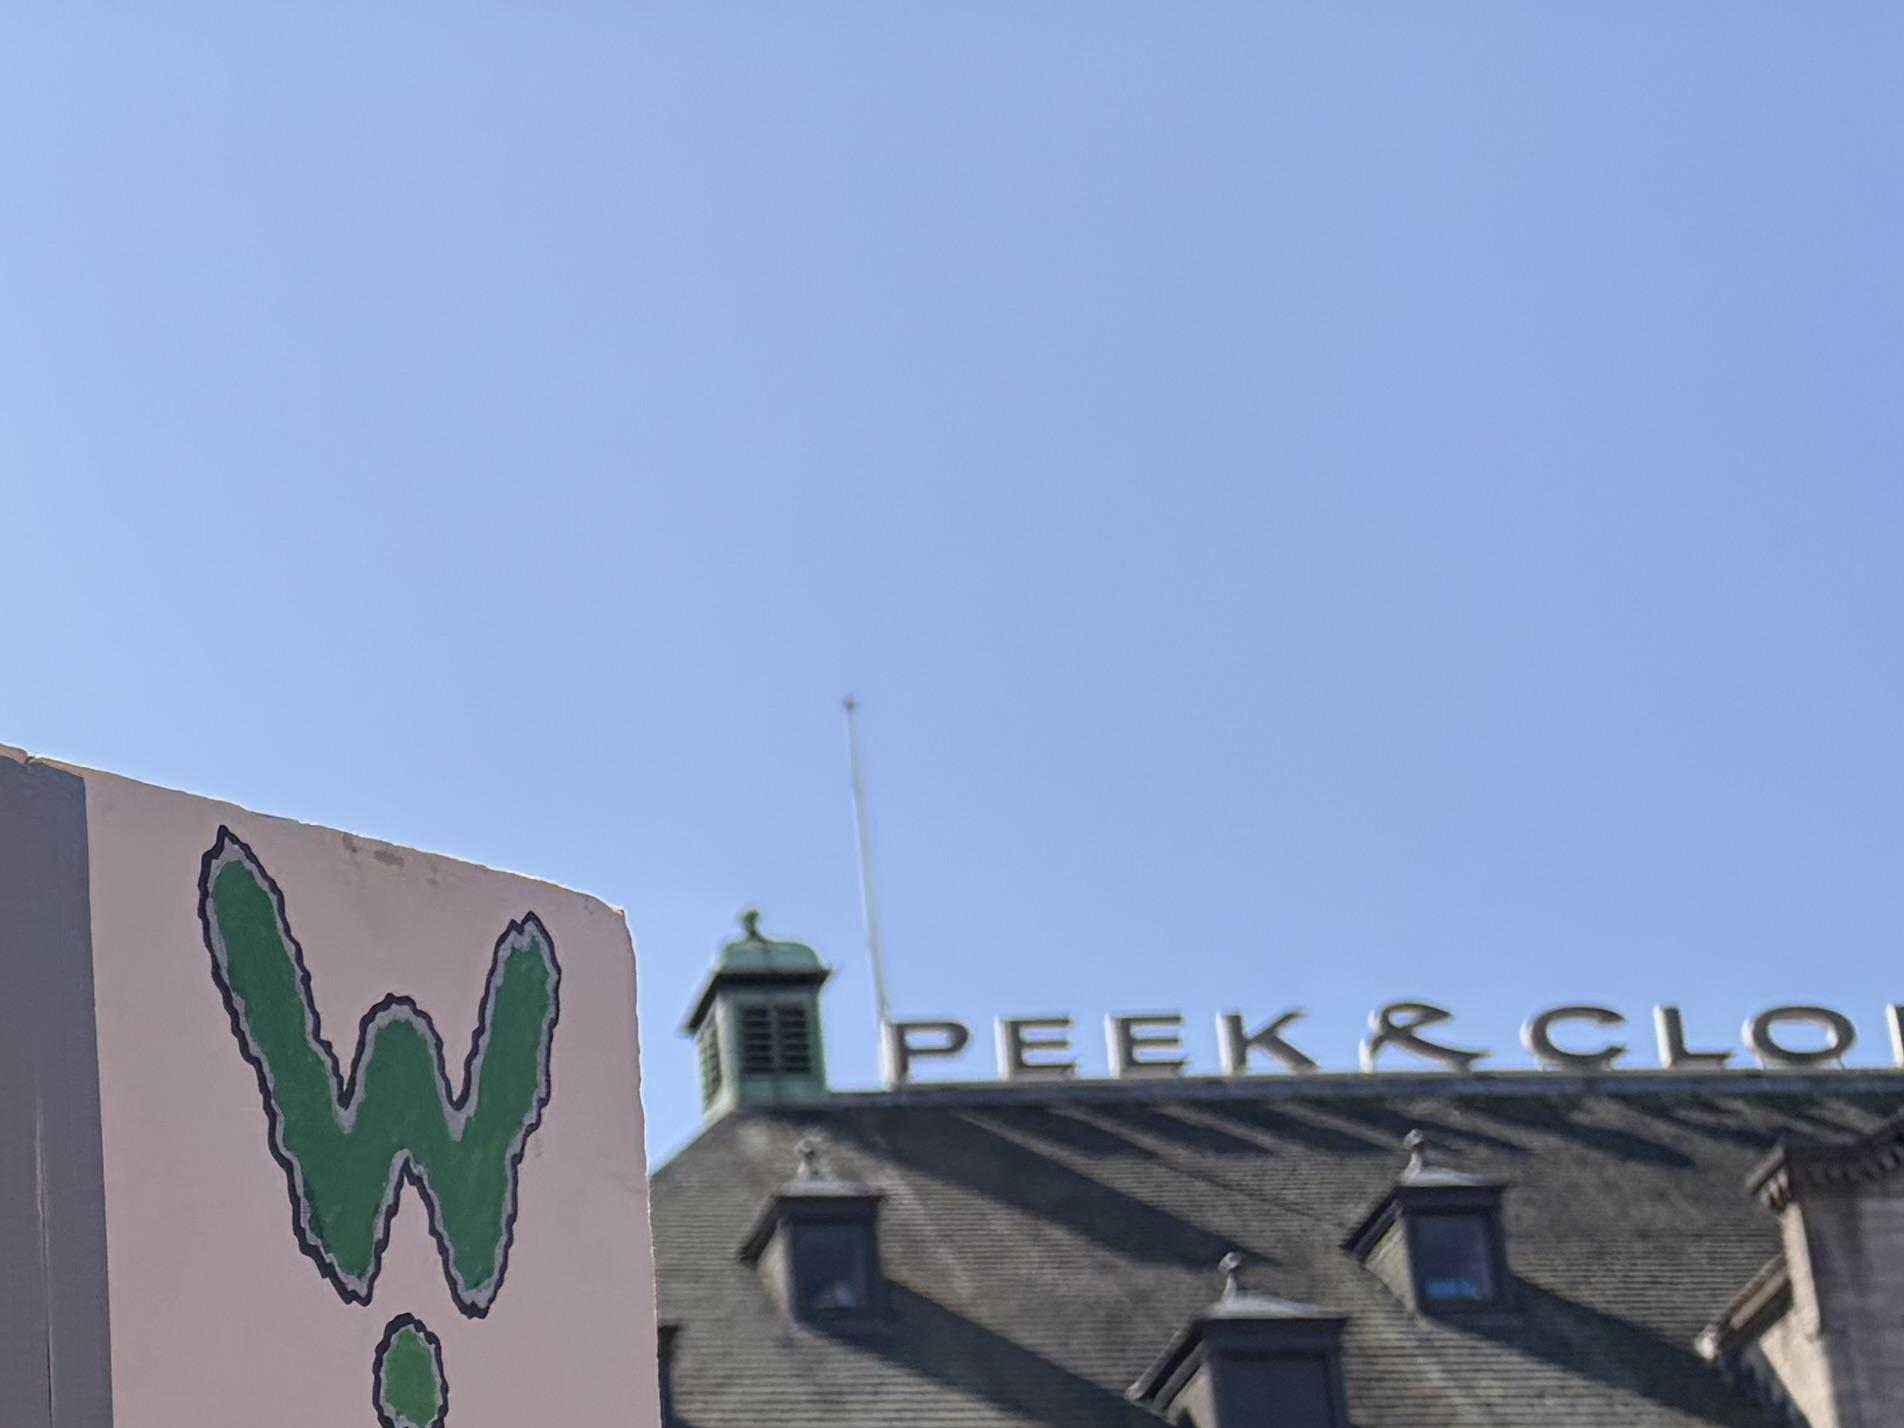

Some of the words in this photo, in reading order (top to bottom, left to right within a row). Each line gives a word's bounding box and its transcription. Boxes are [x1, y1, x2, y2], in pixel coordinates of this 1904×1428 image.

[879, 1008, 1320, 1092] PEEK
[1359, 1000, 1490, 1073] &
[1520, 1001, 1903, 1074] CLO
